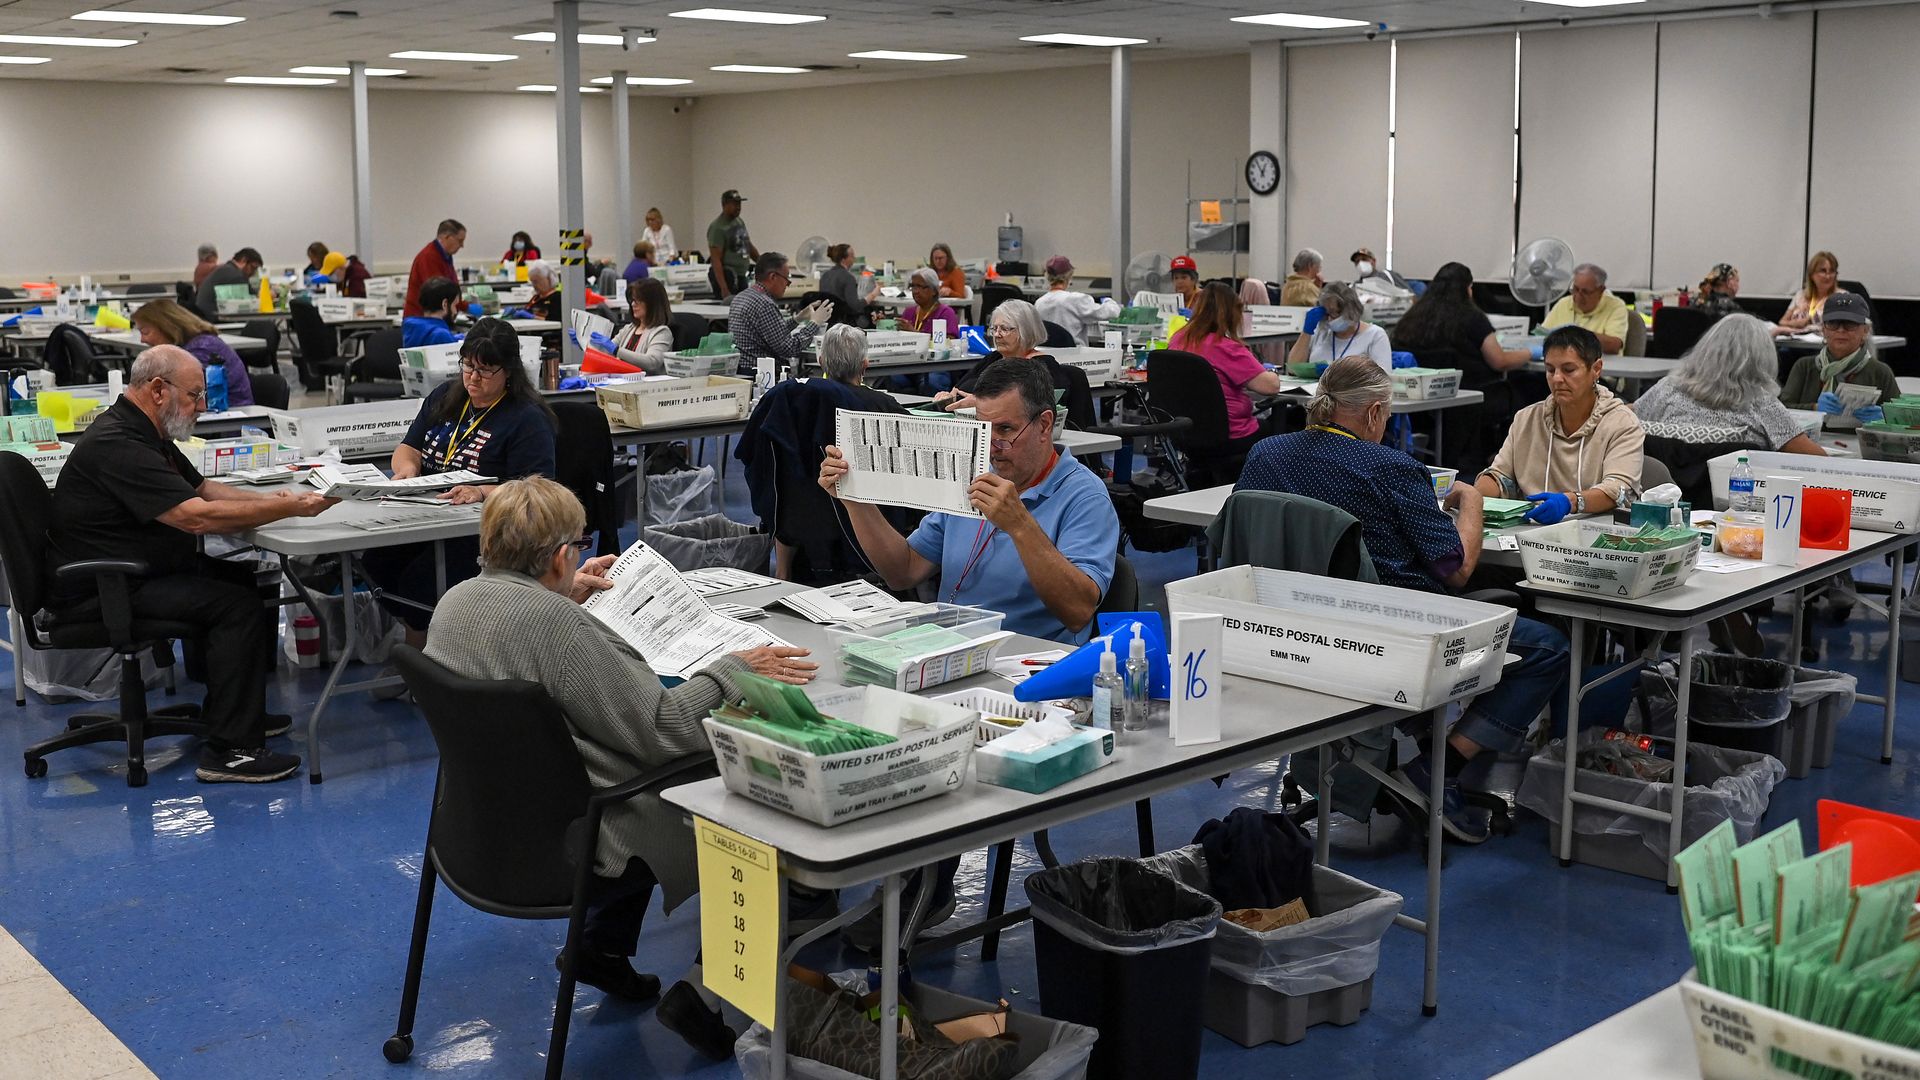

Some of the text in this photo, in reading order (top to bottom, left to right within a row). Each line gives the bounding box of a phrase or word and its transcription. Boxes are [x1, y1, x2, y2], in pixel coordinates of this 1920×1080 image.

[658, 398, 680, 408] PROPERTY
[326, 426, 351, 434] UNITED
[352, 423, 376, 431] STATES
[378, 420, 402, 428] POSTAL
[1773, 494, 1794, 530] 17
[1521, 540, 1639, 564] UNITED STATES POSTAL SERVICE
[1564, 558, 1589, 566] WARNING
[1532, 574, 1545, 582] HALF
[1222, 618, 1384, 657] TED STATES POSTAL SERVICE
[1446, 637, 1466, 648] LABEL
[1270, 650, 1310, 664] EMM TRAY
[1444, 646, 1464, 658] OTHER
[1446, 657, 1458, 666] END
[1184, 649, 1207, 700] 16
[821, 720, 975, 772] UNITED STATES POSTAL SERVICE
[888, 756, 920, 770] WARNING
[834, 807, 852, 817] HALF
[854, 802, 866, 812] MM
[868, 798, 888, 809] TRAY
[713, 835, 757, 860] TABLES 16-20
[731, 866, 743, 882] 20
[733, 891, 744, 906] 19
[734, 916, 745, 932] 18
[734, 940, 745, 955] 17
[734, 964, 744, 982] 16
[1700, 1000, 1752, 1028] LABEL
[1701, 1014, 1756, 1044] OTHER
[1713, 1034, 1748, 1055] END
